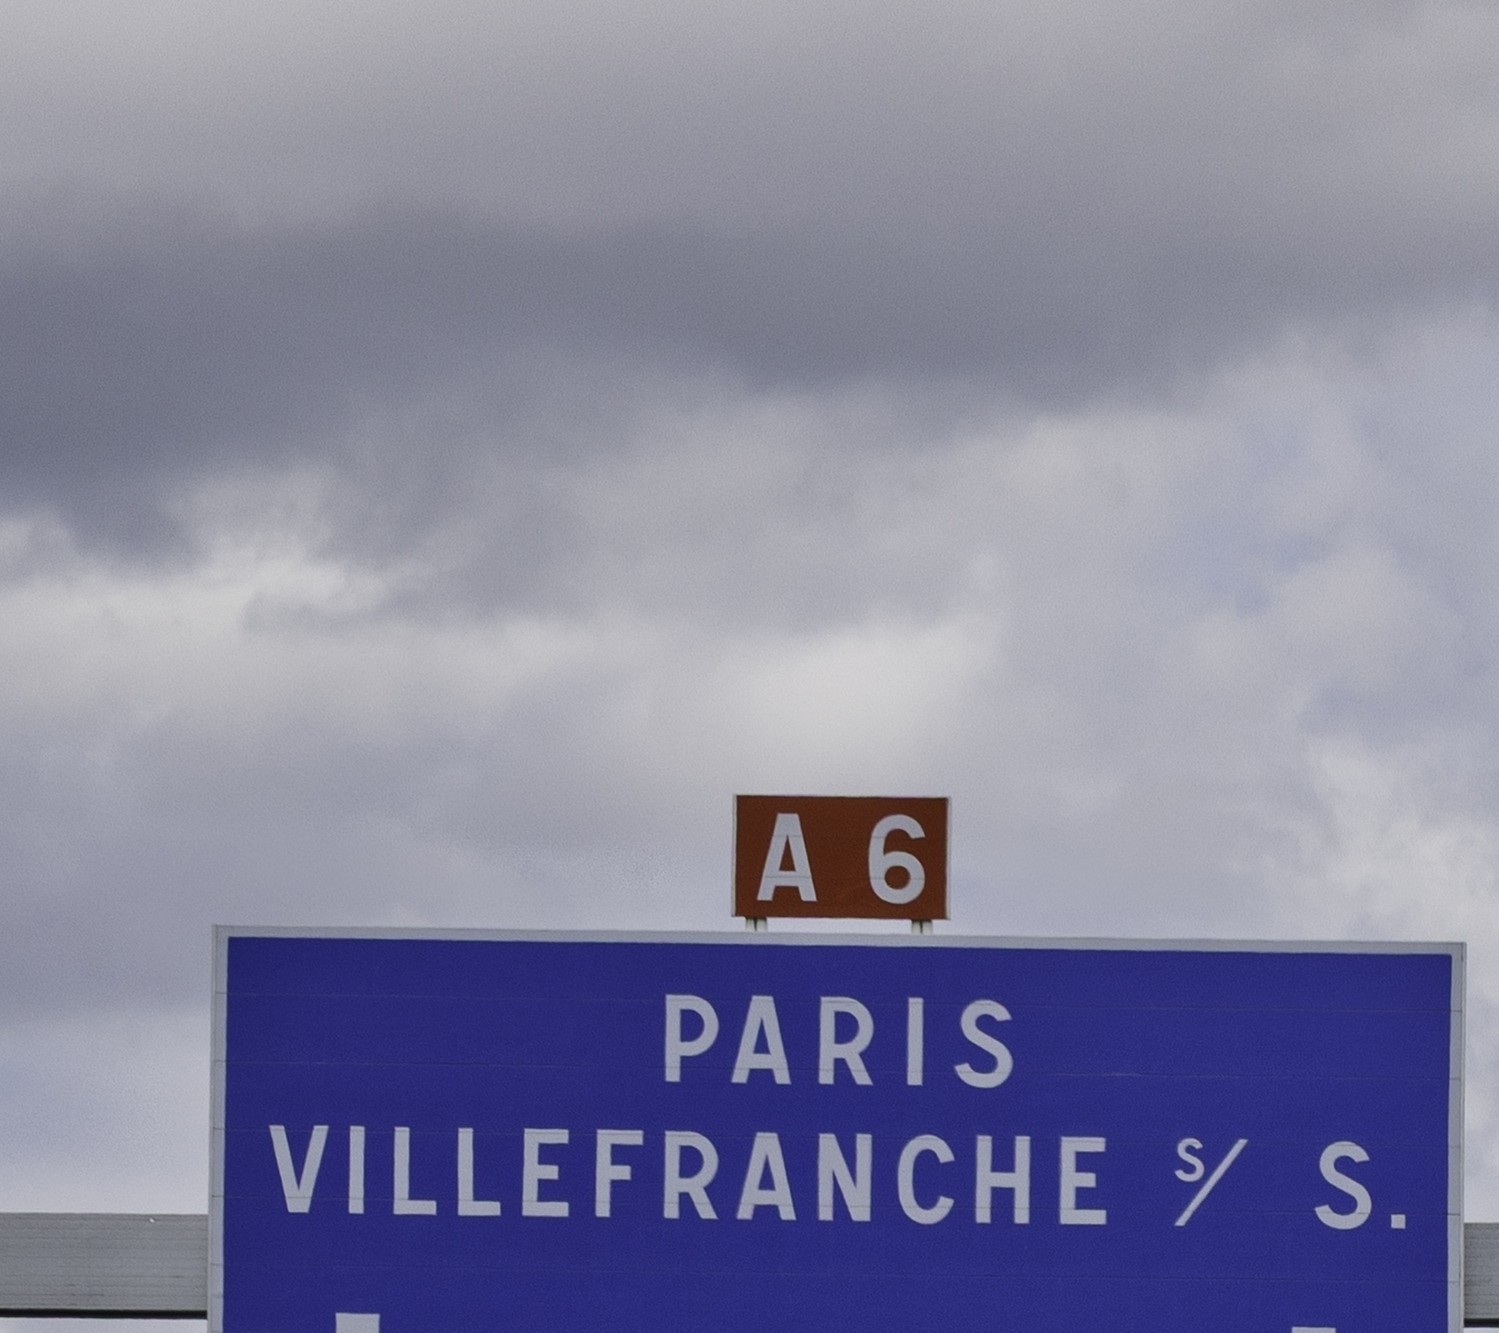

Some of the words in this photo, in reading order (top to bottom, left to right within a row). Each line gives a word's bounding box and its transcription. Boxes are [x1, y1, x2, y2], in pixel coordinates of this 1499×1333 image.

[757, 812, 817, 902] A
[868, 814, 926, 905] 6
[664, 994, 1013, 1089] PARIS
[269, 1124, 1108, 1225] VILLEFRANCHE
[1314, 1140, 1406, 1230] S.
